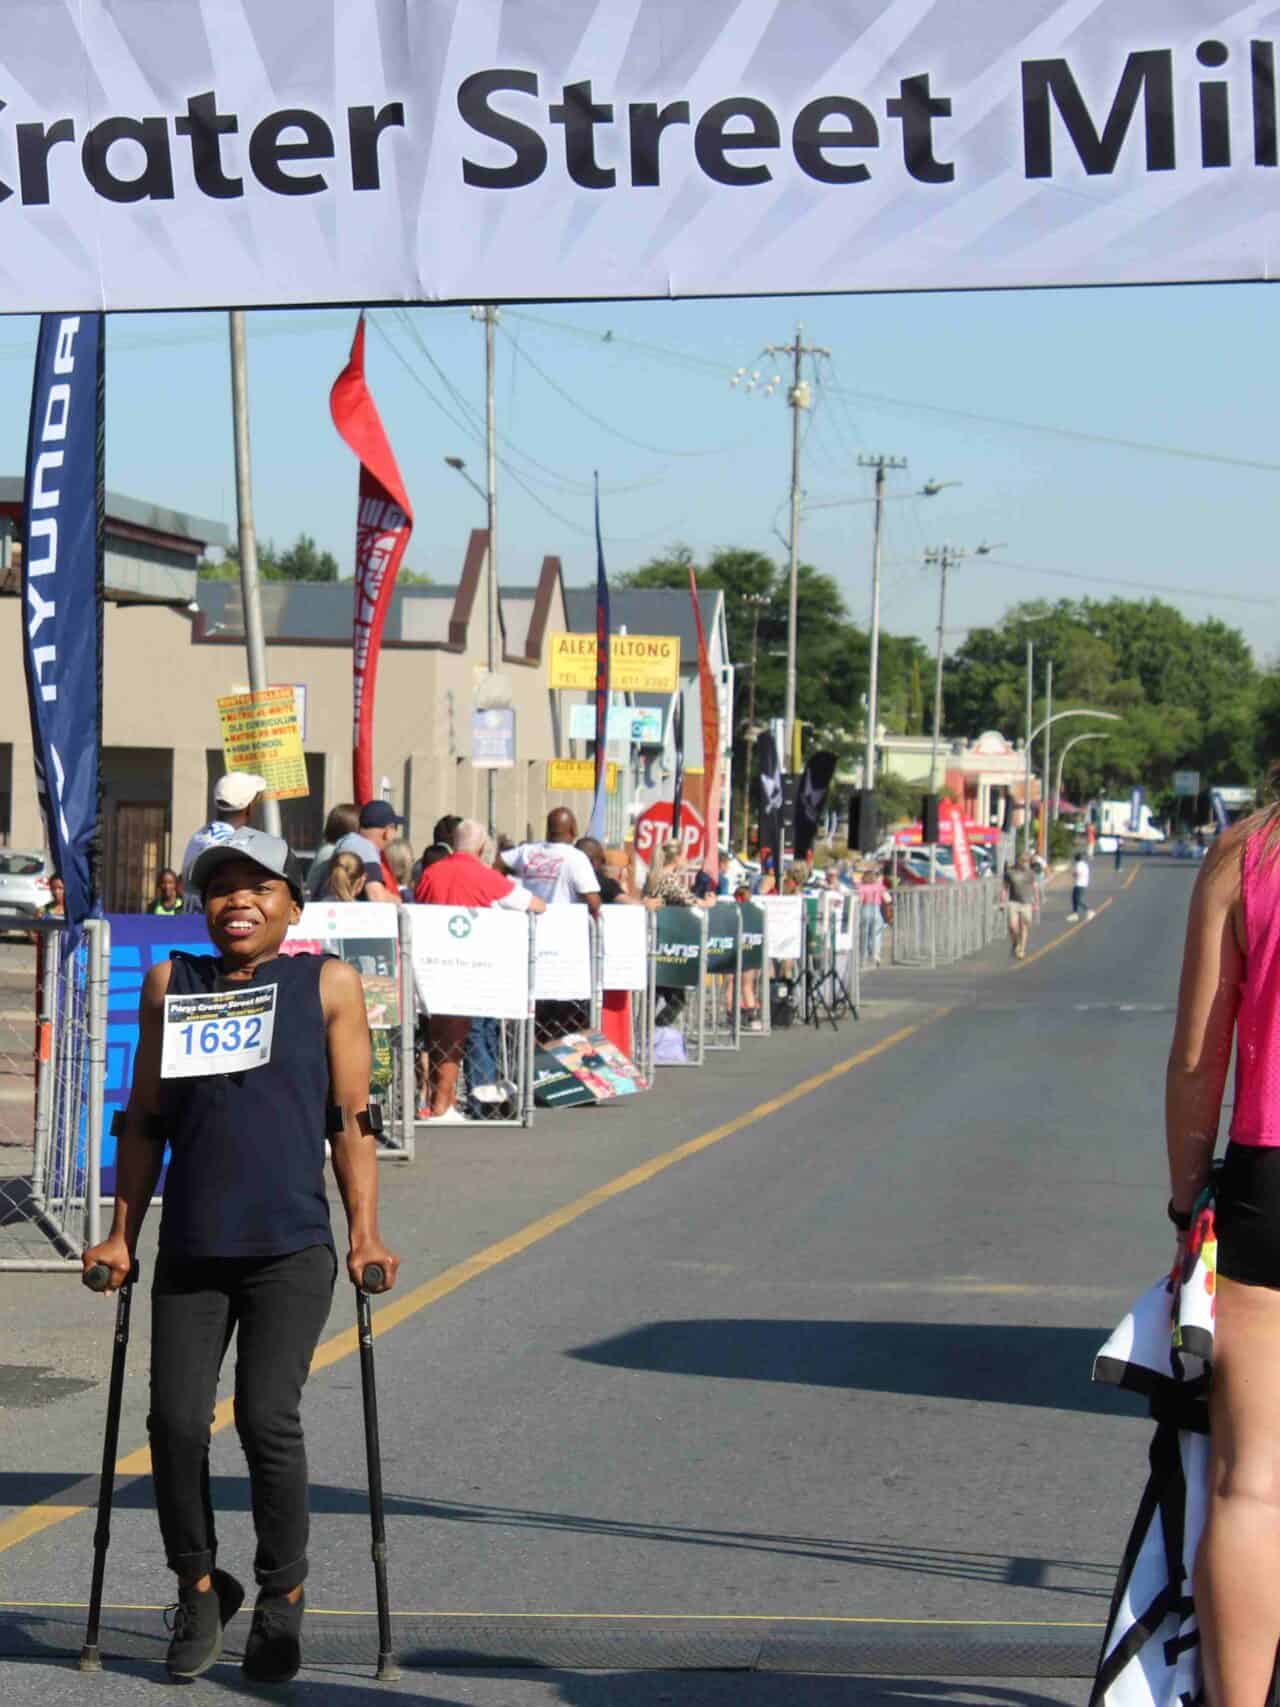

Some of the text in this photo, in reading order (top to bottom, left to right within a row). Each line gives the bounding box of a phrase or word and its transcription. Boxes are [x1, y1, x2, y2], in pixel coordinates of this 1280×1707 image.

[456, 68, 955, 188] Street
[559, 639, 672, 657] ALEX ILTONG
[180, 1017, 262, 1056] 1632
